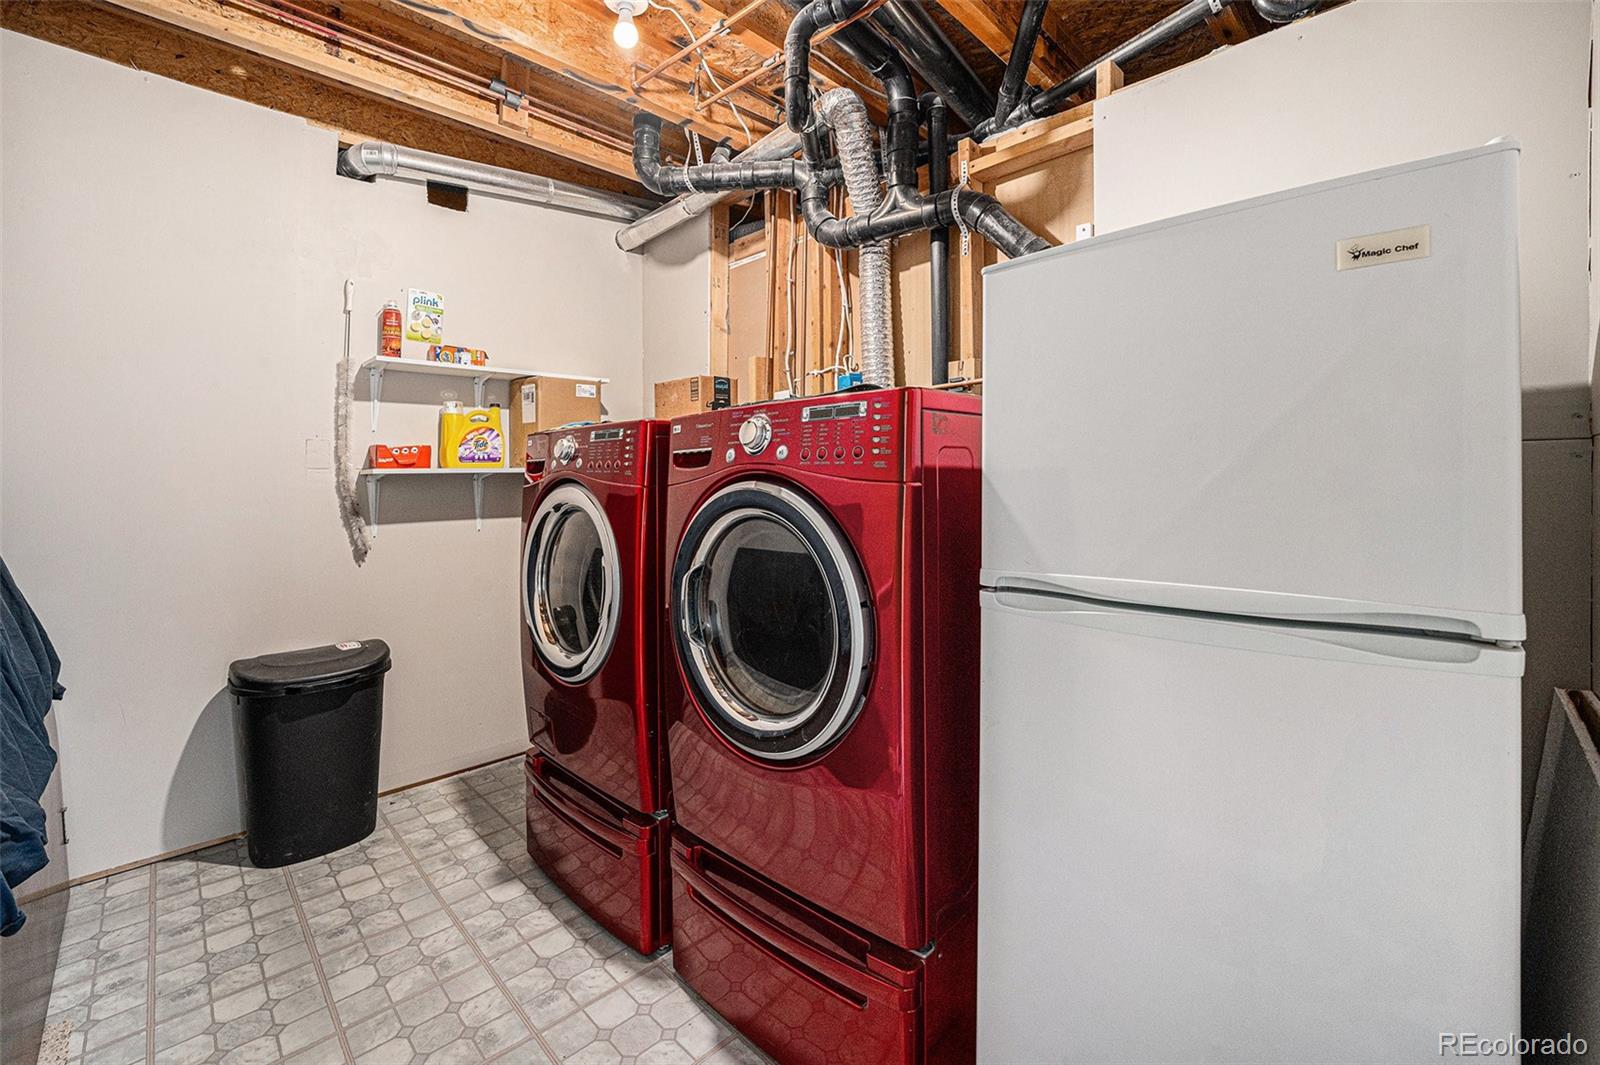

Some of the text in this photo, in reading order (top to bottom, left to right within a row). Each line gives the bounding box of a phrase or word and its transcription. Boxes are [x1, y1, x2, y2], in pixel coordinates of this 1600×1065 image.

[1361, 242, 1420, 258] Magic Chef
[412, 295, 439, 308] plink
